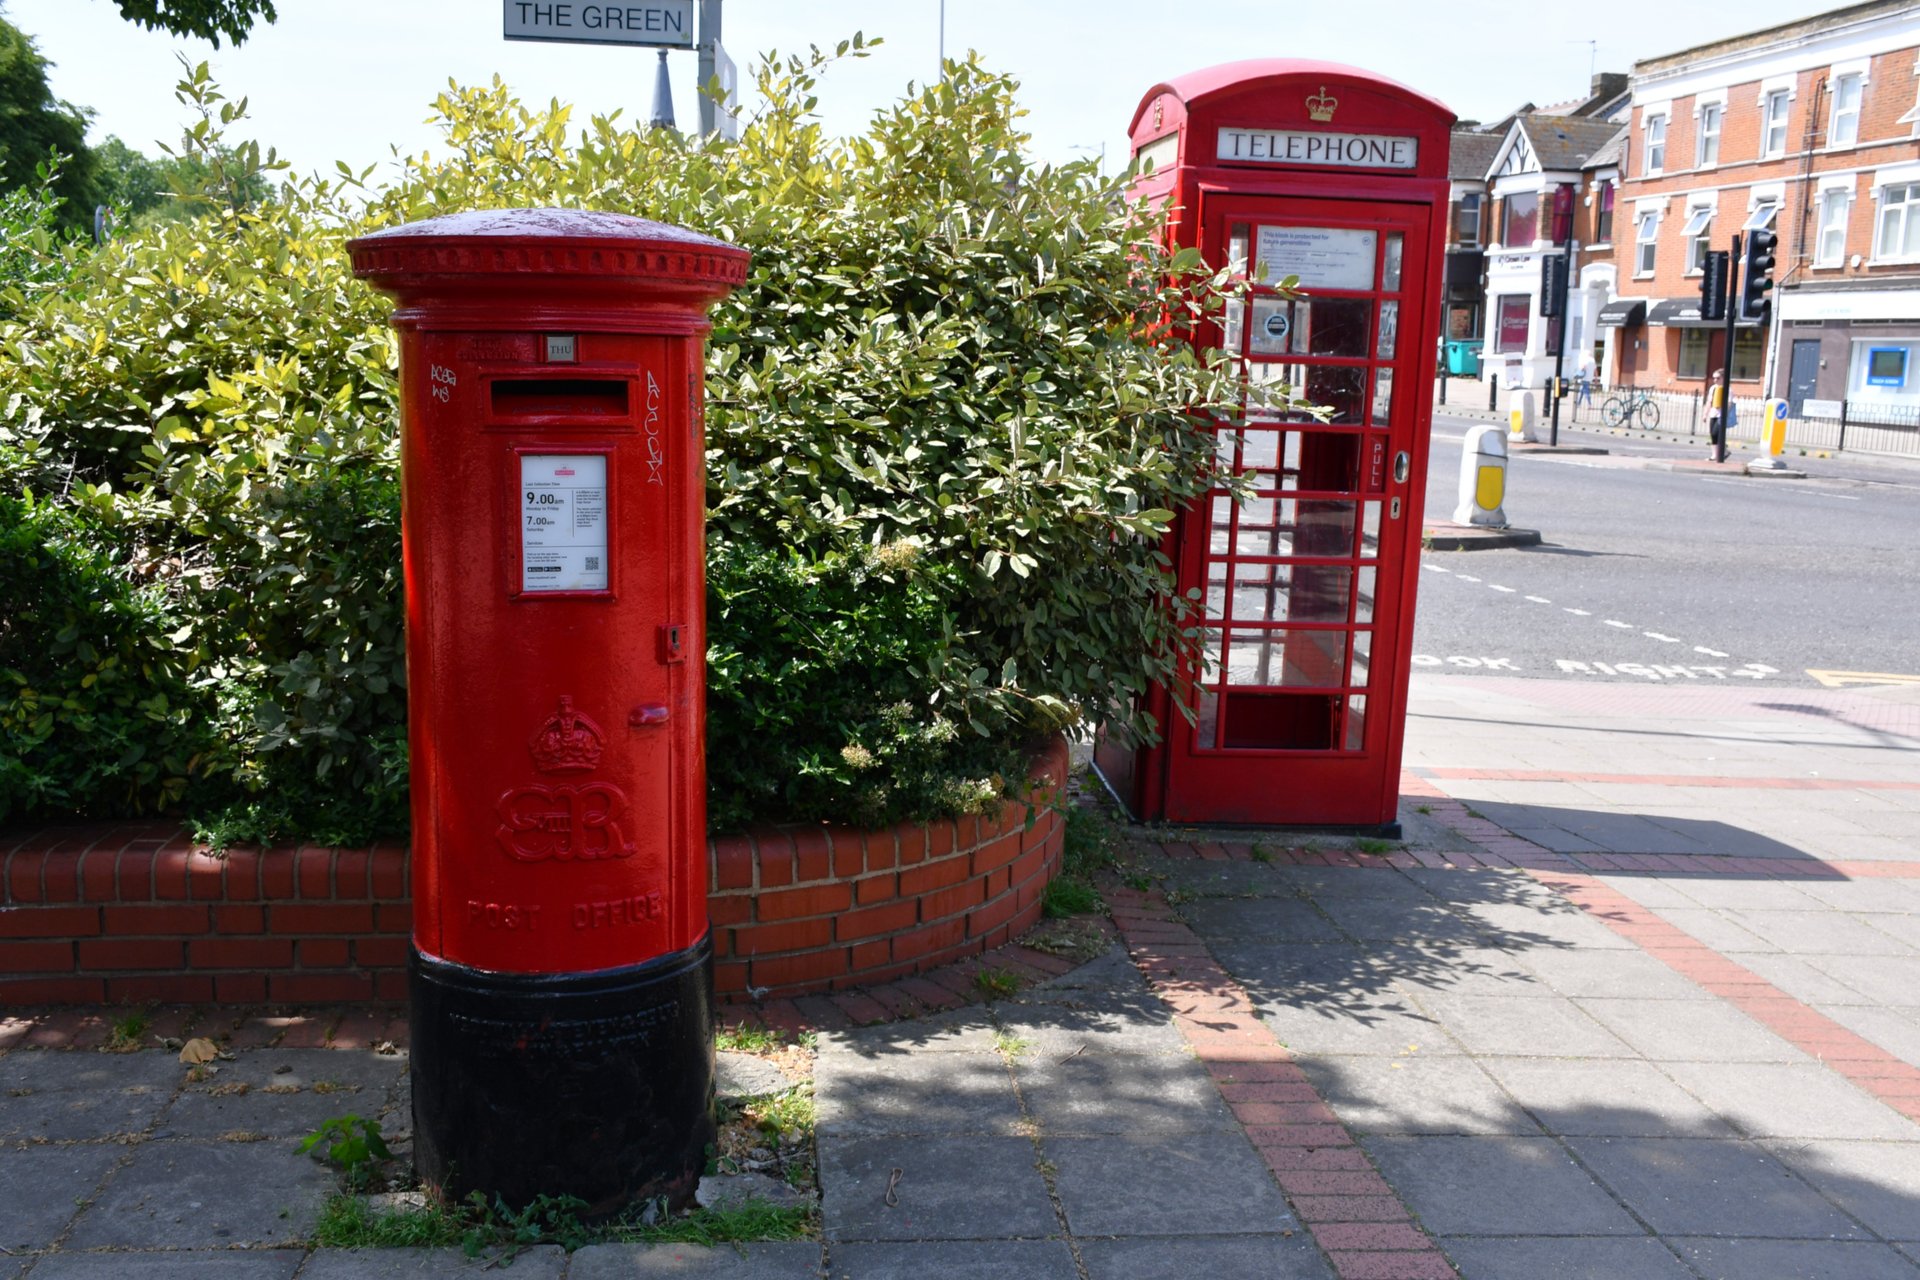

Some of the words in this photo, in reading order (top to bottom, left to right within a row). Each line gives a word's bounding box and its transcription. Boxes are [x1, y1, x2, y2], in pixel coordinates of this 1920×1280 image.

[515, 1, 572, 27] THE
[582, 5, 682, 33] GREEN
[1228, 133, 1407, 164] TELEPHONE
[551, 345, 572, 354] THU
[1371, 443, 1382, 487] PULL
[468, 900, 541, 930] POST
[572, 891, 661, 930] OFFICE
